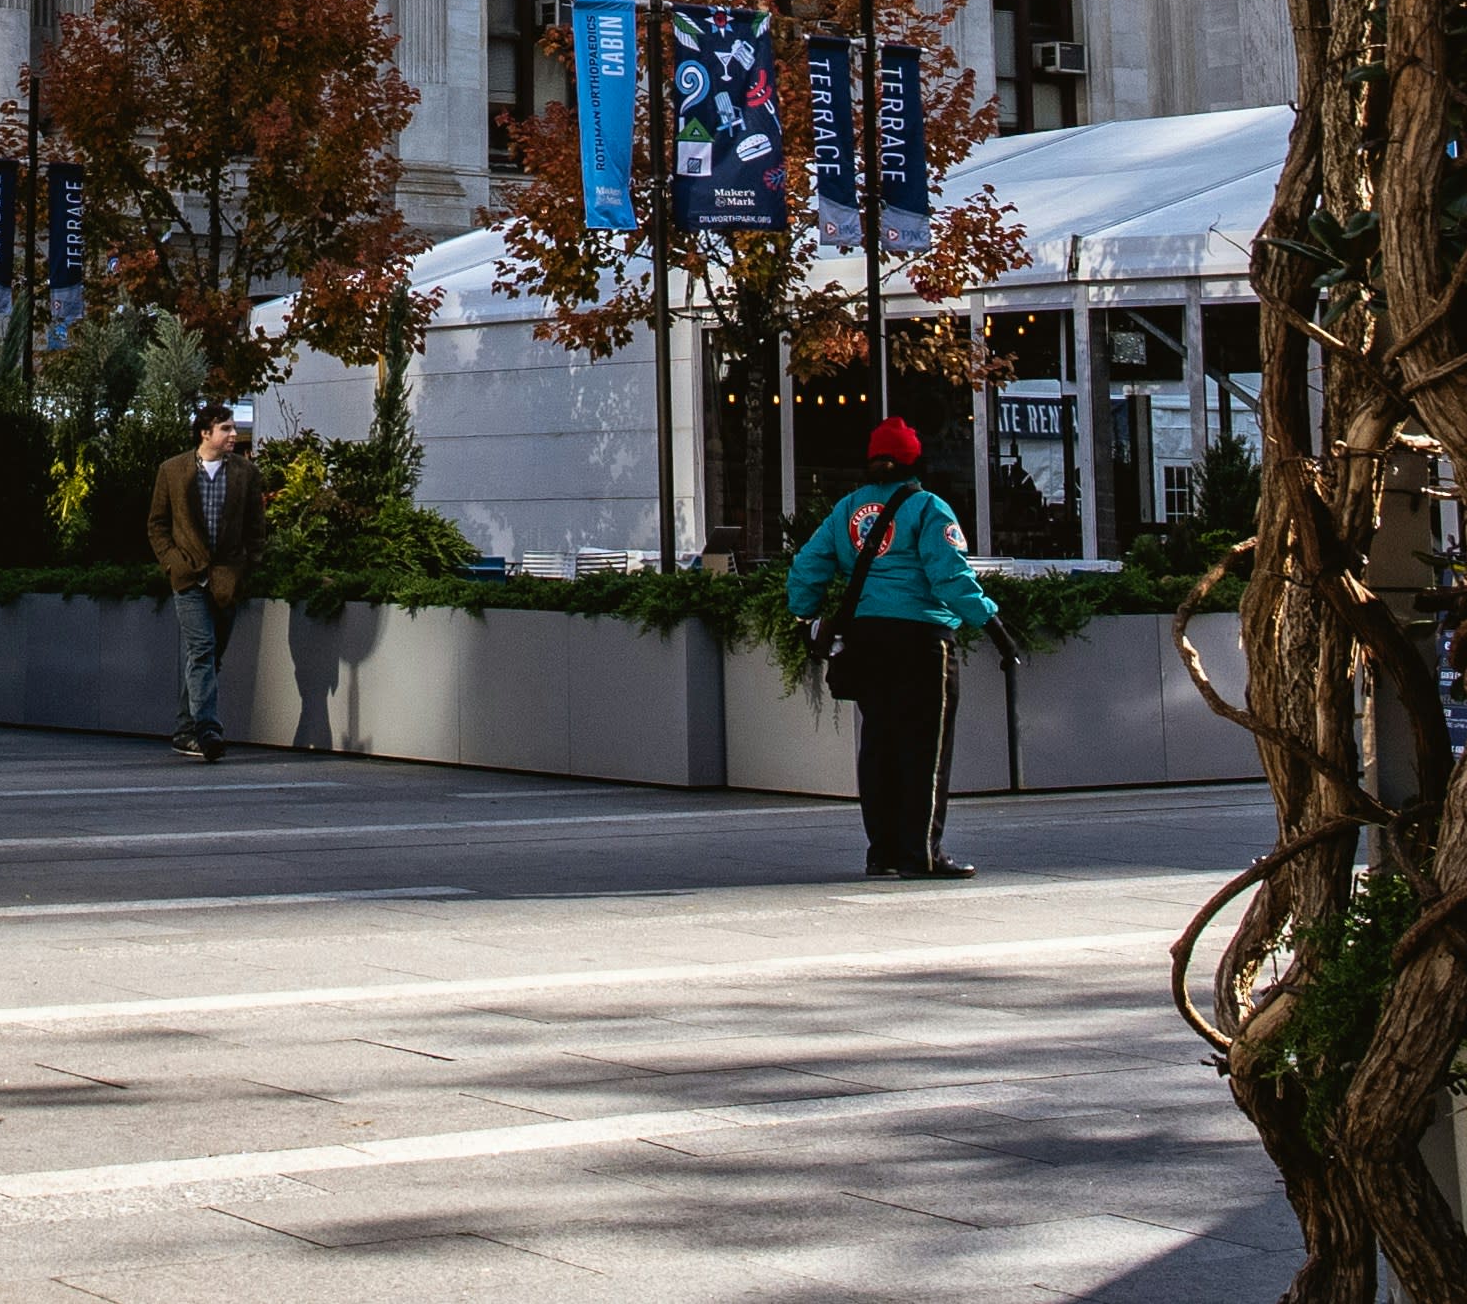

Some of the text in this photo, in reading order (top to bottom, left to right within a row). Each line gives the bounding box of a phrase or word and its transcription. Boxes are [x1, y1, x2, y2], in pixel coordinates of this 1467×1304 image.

[598, 16, 625, 76] CABIN
[587, 15, 607, 171] ROTHMAN ORTHOPAEDICS
[808, 58, 841, 176] TERRACE
[880, 66, 906, 183] TERRACE
[66, 180, 84, 270] TERRACE
[714, 188, 755, 197] Maker's
[727, 197, 755, 206] Mark
[852, 505, 878, 526] CENTER
